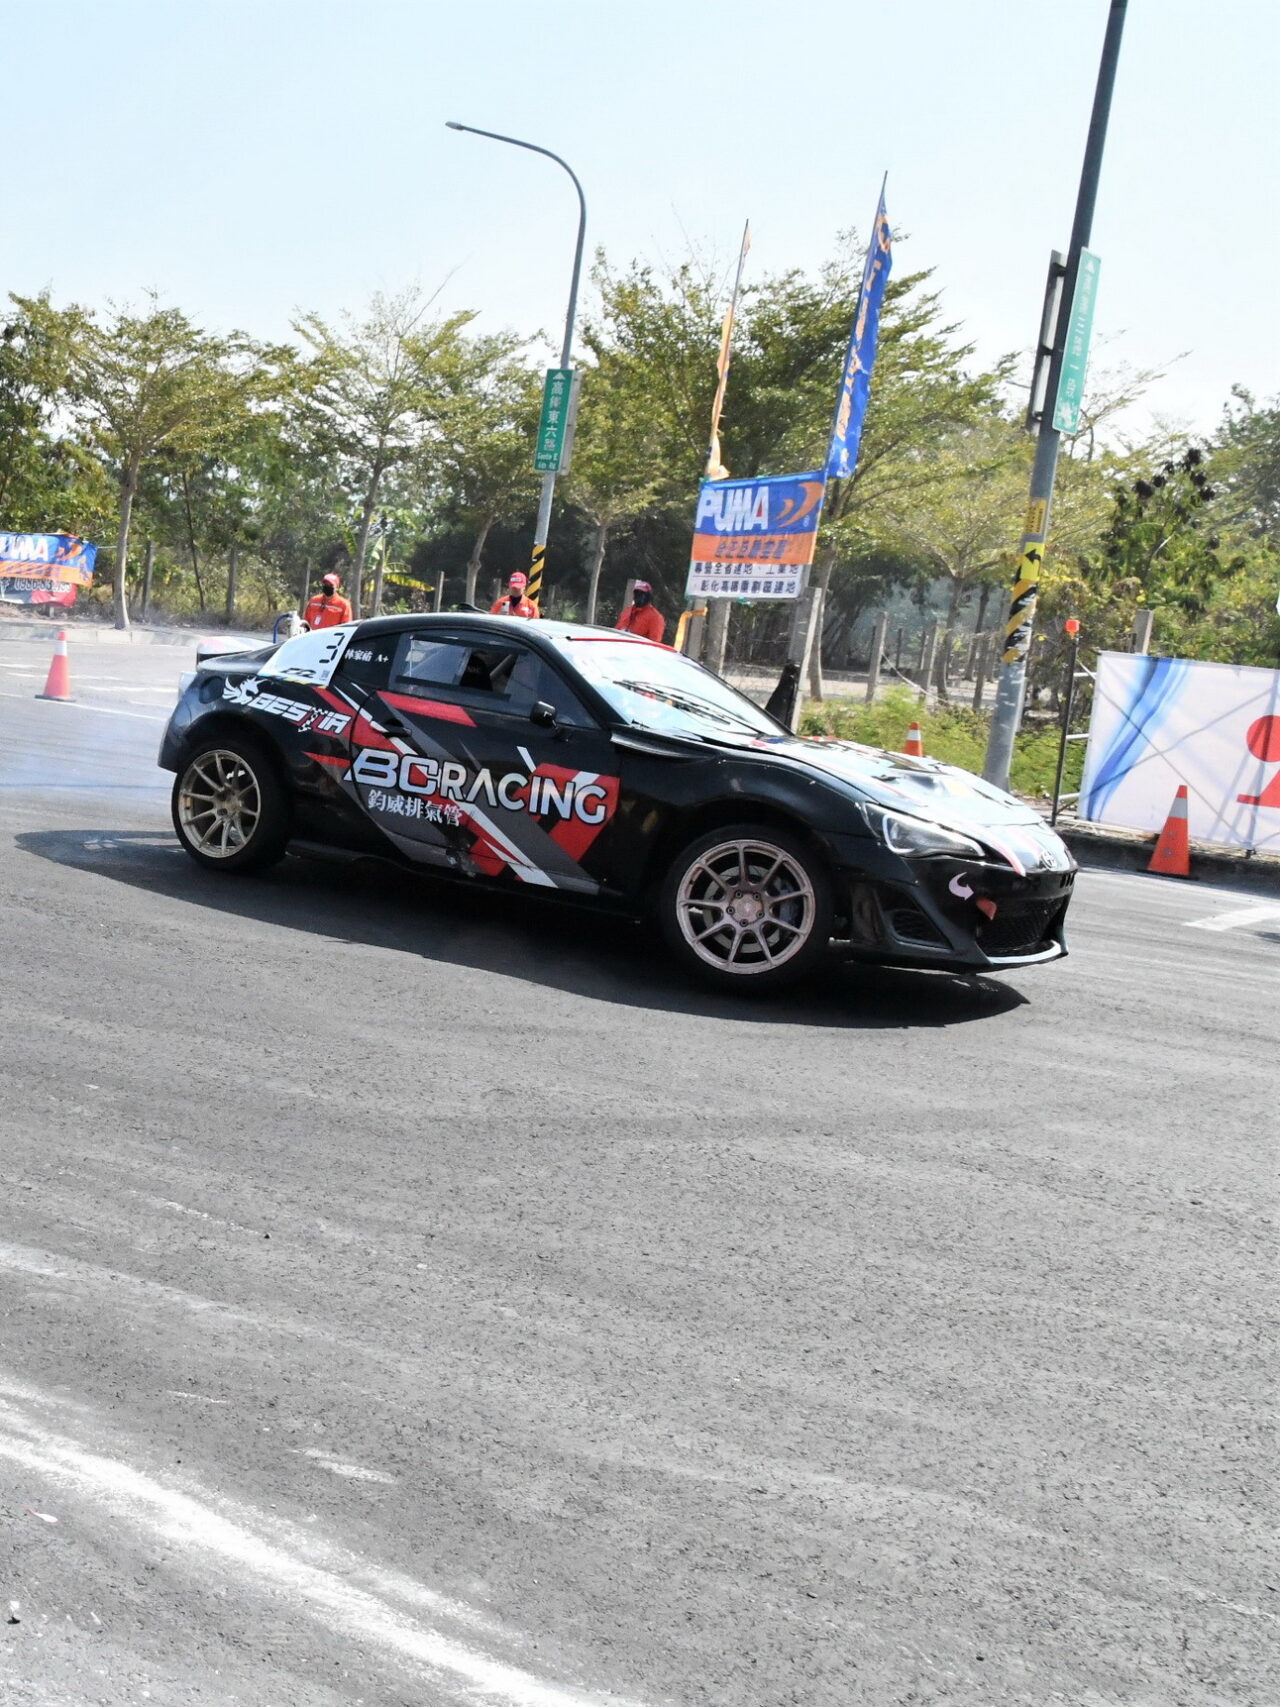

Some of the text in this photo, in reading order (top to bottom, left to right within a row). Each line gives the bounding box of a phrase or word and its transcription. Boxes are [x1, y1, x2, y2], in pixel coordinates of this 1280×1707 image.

[696, 486, 769, 532] PUMA
[368, 789, 462, 828] 鈞威排氣管
